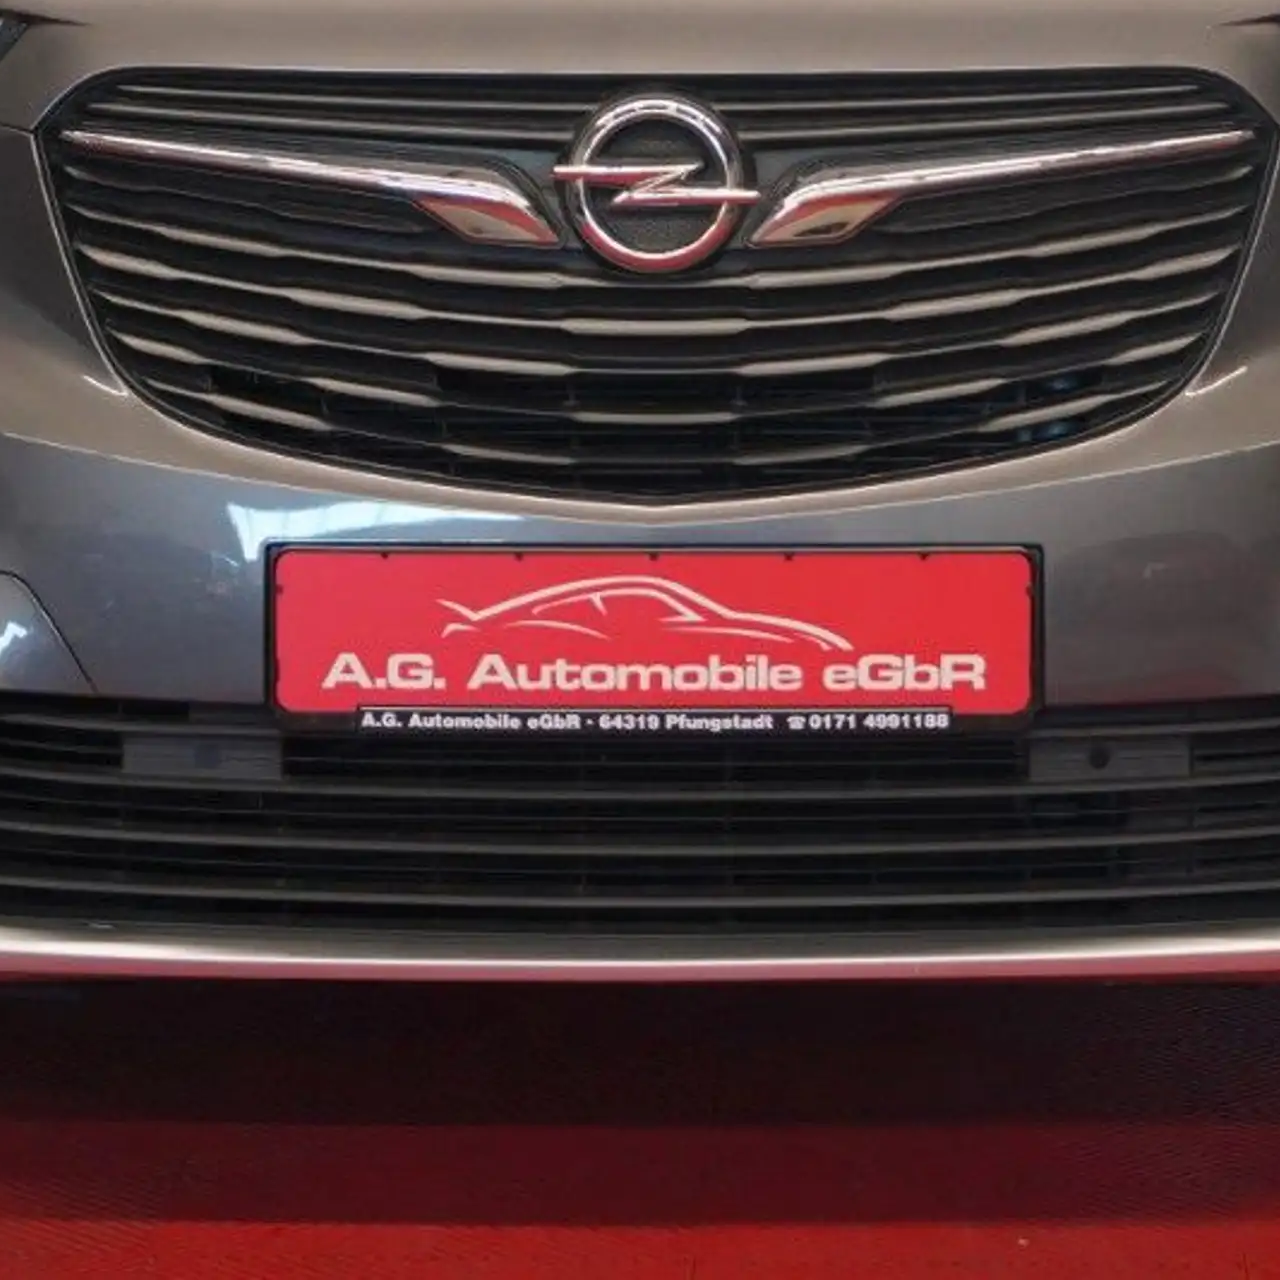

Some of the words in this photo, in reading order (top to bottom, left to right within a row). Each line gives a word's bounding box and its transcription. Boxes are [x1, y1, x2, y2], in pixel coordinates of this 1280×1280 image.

[321, 653, 446, 691] A.G.
[467, 652, 803, 691] Automobile
[822, 653, 986, 691] eGbR
[361, 712, 402, 729] A.G.
[408, 713, 521, 730] Automobile
[527, 713, 581, 730] eGbR
[599, 714, 658, 730] 64319
[665, 713, 774, 733] Pfungstadt
[808, 713, 857, 730] 0171
